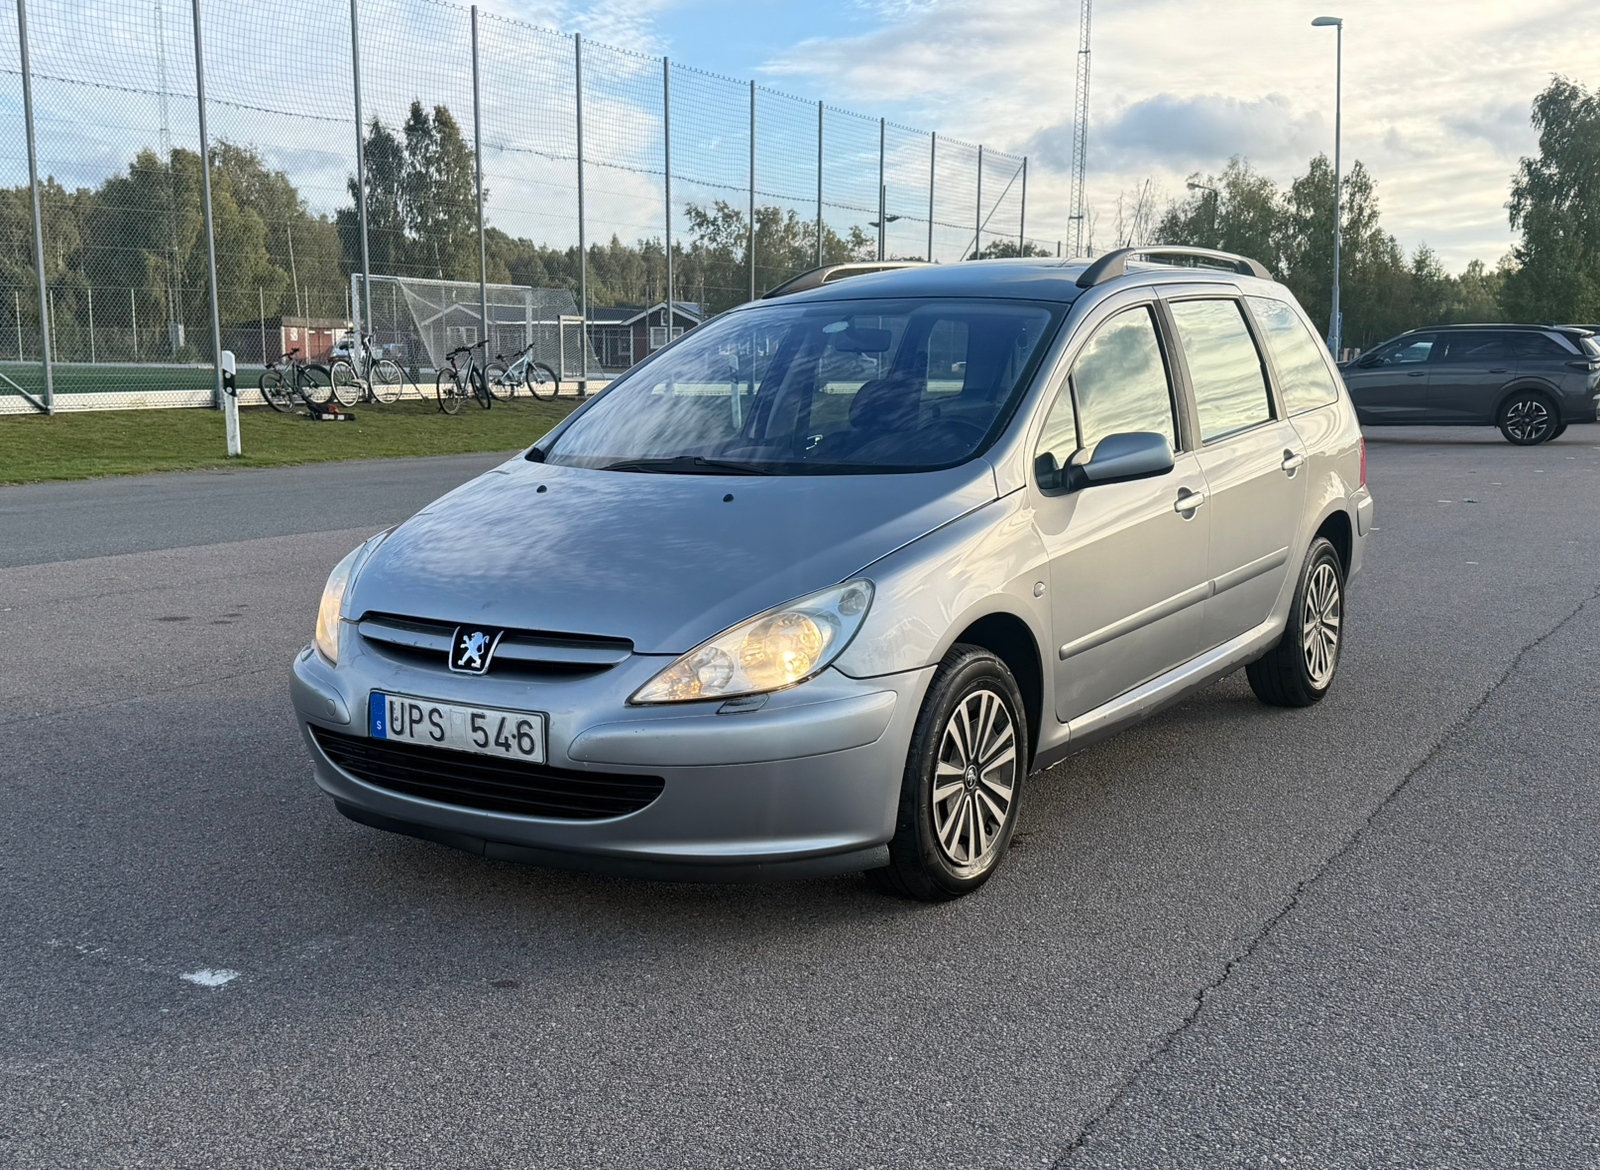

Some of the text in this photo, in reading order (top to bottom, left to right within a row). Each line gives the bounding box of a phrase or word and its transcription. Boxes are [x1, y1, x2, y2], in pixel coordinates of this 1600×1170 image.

[376, 720, 383, 730] S
[389, 700, 535, 756] UPS 546
